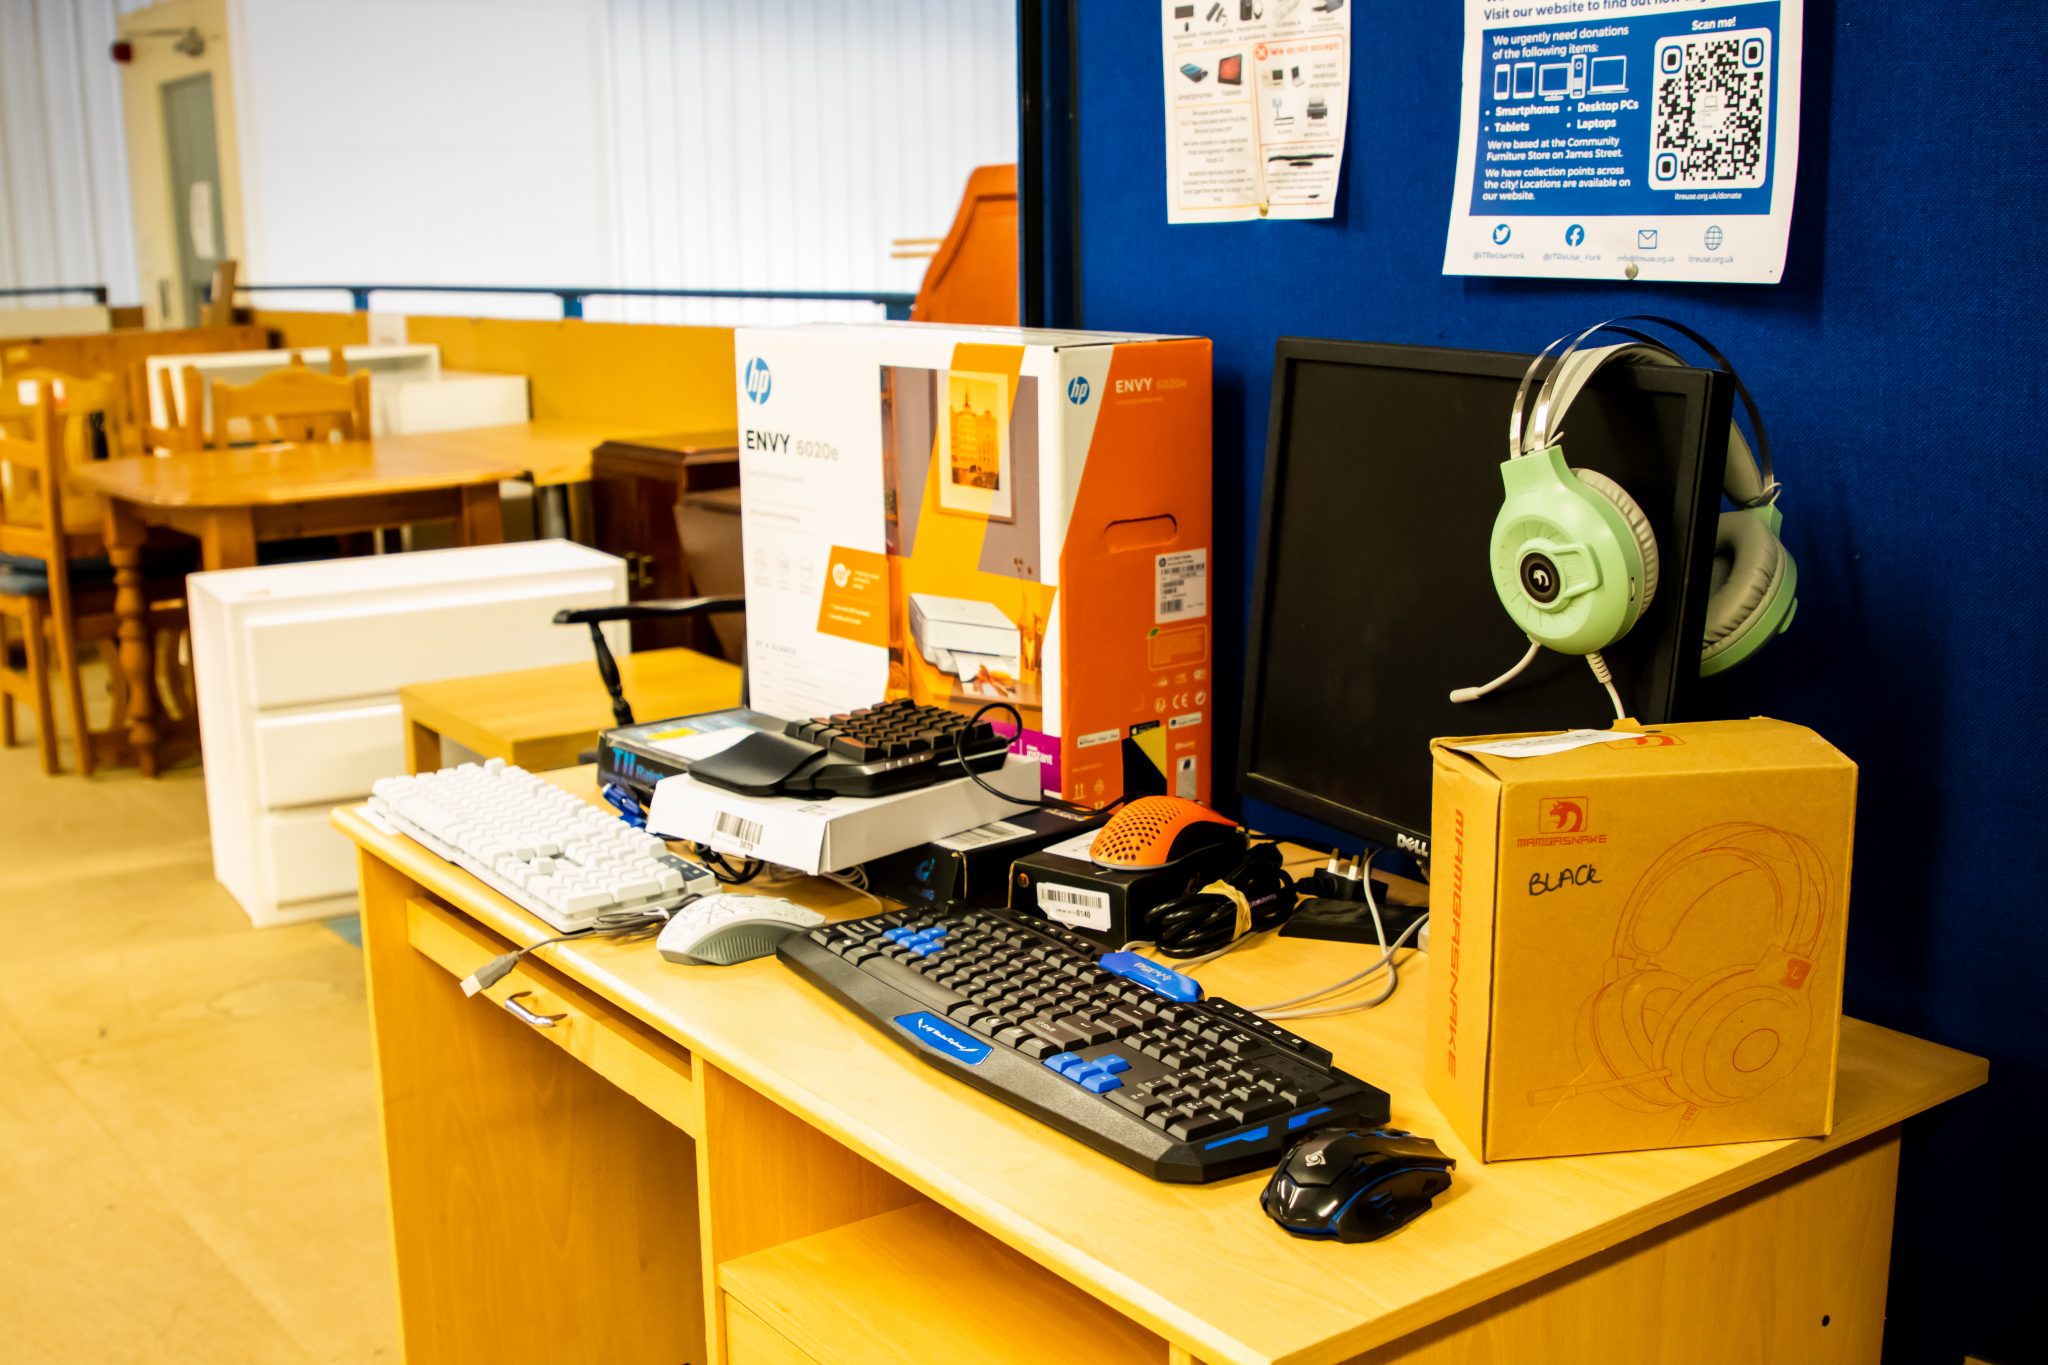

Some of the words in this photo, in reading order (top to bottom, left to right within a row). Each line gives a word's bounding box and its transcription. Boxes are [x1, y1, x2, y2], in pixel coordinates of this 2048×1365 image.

[1484, 8, 1509, 20] Visit
[1513, 8, 1532, 17] our
[1536, 2, 1585, 16] website
[1588, 1, 1600, 11] to
[1691, 19, 1715, 30] Scan
[1717, 16, 1737, 28] me!
[1493, 35, 1508, 46] We
[1511, 32, 1551, 46] urgently
[1553, 29, 1577, 41] need
[1579, 25, 1629, 38] donations
[1492, 49, 1502, 60] of
[1504, 48, 1520, 59] the
[1522, 45, 1567, 58] following
[1495, 105, 1560, 117] Smartphones
[1577, 101, 1619, 113] Desktop
[1620, 99, 1639, 110] PCs
[1495, 122, 1530, 132] Tablets
[1577, 119, 1616, 131] Laptops
[1487, 140, 1512, 150] We're
[1513, 139, 1540, 149] based
[1541, 140, 1550, 149] at
[1551, 138, 1566, 148] the
[1567, 136, 1619, 148] Community
[1486, 151, 1526, 161] Furniture
[1528, 150, 1551, 160] Store
[1552, 152, 1564, 160] on
[1565, 149, 1593, 159] James
[1595, 148, 1623, 158] Street.
[1485, 168, 1499, 178] We
[1501, 168, 1522, 178] have
[1523, 166, 1565, 177] collection
[1568, 166, 1595, 178] points
[1597, 167, 1624, 175] across
[1484, 180, 1499, 189] the
[1520, 178, 1561, 189] Locations
[1563, 180, 1577, 188] are
[1578, 177, 1617, 187] available
[1619, 179, 1631, 187] on
[1482, 192, 1497, 200] our
[1499, 191, 1535, 200] website.
[745, 357, 771, 405] hp
[1115, 378, 1152, 394] ENVY
[1068, 376, 1090, 405] hp
[746, 430, 790, 454] ENVY
[796, 440, 839, 461] 6020e
[1396, 833, 1428, 857] DELL
[1517, 834, 1608, 849] MAMBASNAKE
[1448, 808, 1464, 1079] MAMBASNAKE
